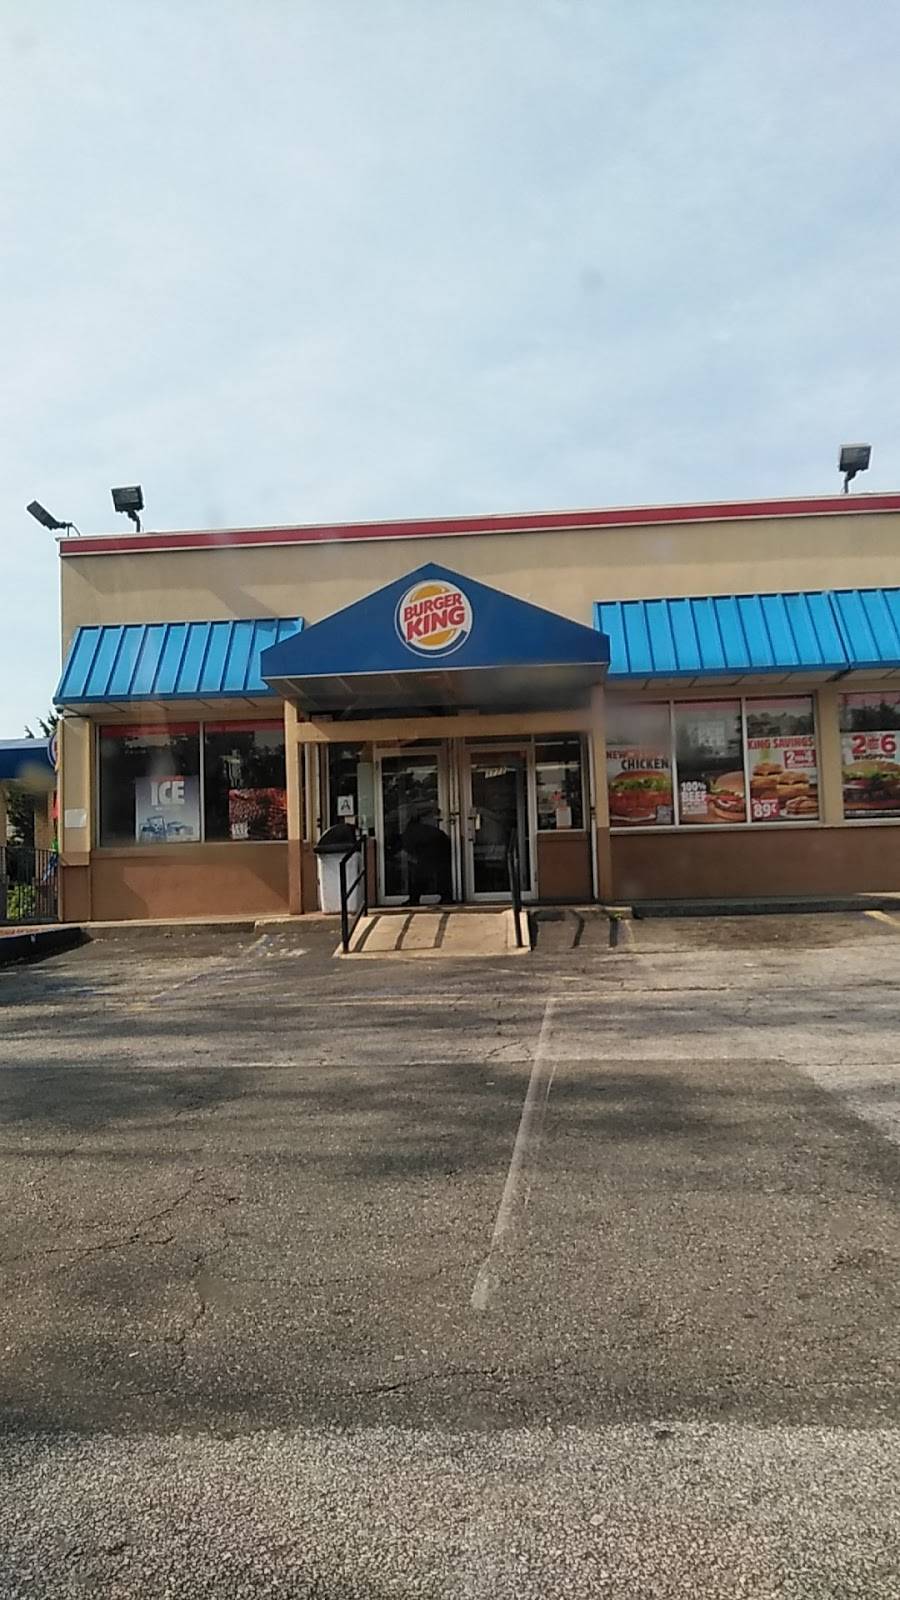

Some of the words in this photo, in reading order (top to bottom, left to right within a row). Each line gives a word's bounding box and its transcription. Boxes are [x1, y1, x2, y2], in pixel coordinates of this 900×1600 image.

[404, 593, 462, 622] BURGER
[406, 606, 465, 641] KING
[748, 740, 770, 750] KING
[774, 737, 814, 749] SAVINGS
[852, 735, 867, 754] 2
[881, 734, 897, 754] 6
[786, 751, 796, 764] 2
[621, 759, 670, 771] CHICKEN
[681, 781, 707, 792] 100%
[151, 781, 185, 806] ICE
[681, 791, 707, 802] BEEF
[341, 799, 351, 810] A
